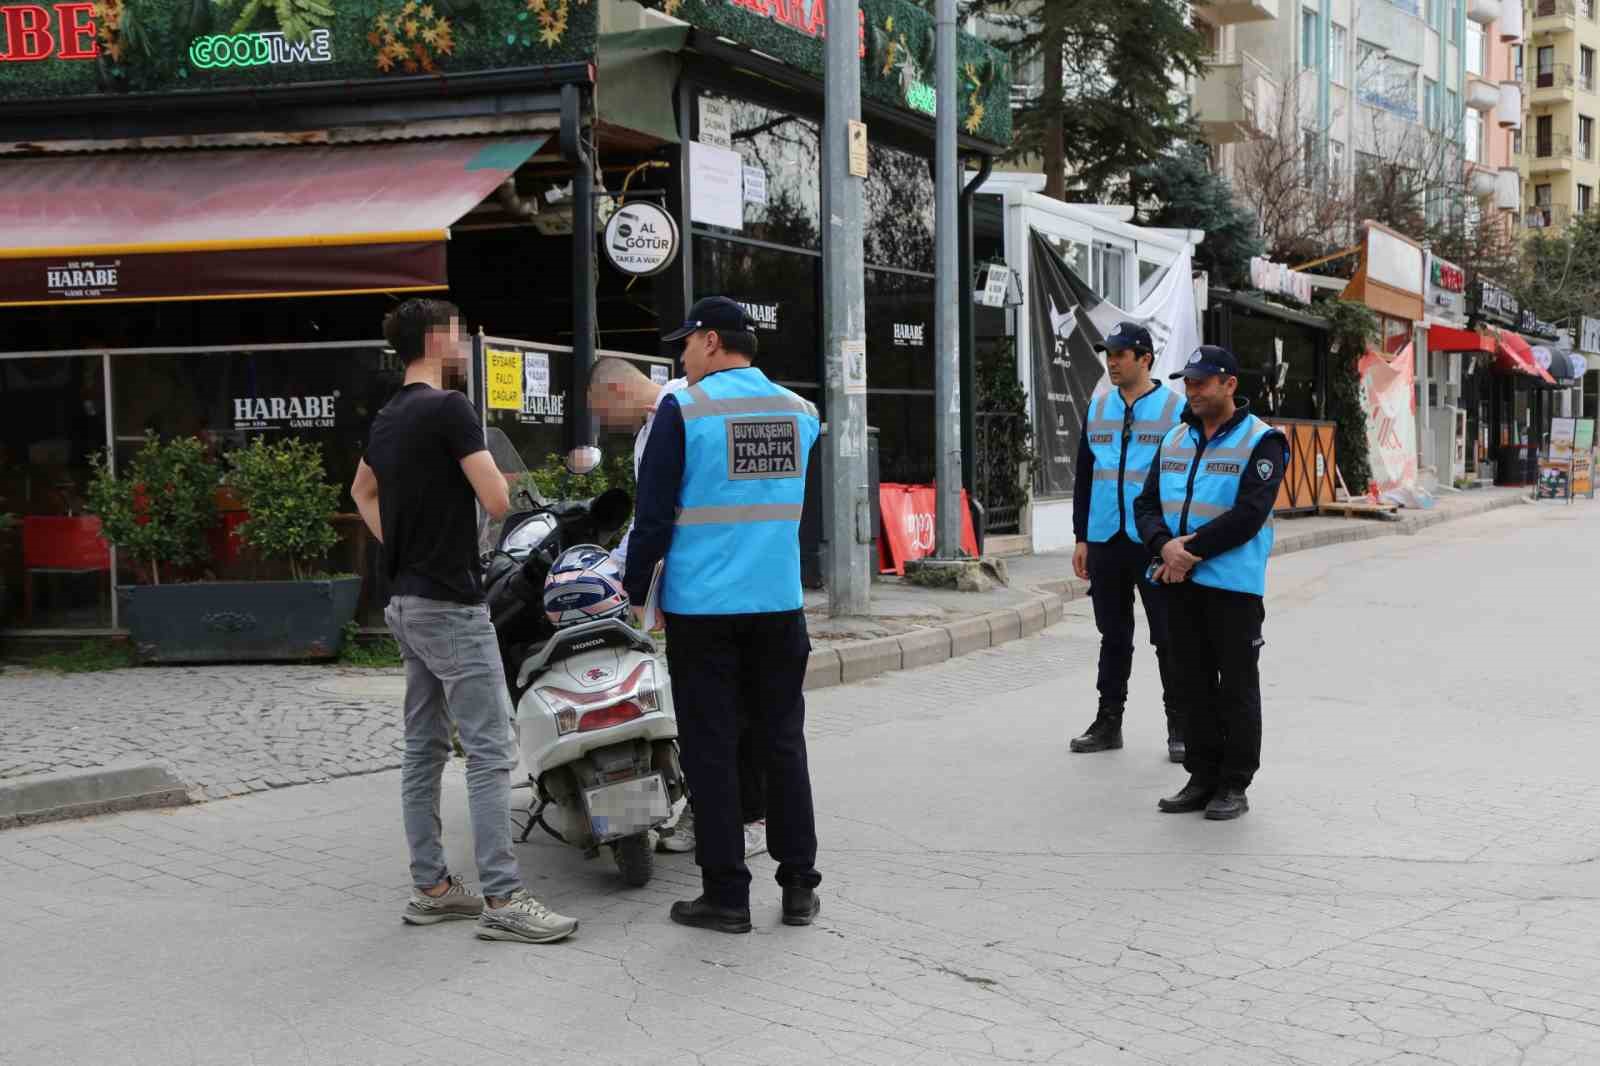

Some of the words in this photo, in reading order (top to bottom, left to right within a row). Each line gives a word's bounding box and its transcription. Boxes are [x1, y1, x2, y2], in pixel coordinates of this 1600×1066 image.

[0, 3, 98, 61] BE
[640, 223, 656, 233] AL
[625, 236, 669, 249] GÖTÜR
[615, 255, 634, 264] TAKE
[47, 269, 118, 288] HARABE
[736, 302, 777, 323] ARABE
[234, 396, 335, 420] HARABE
[289, 419, 313, 428] GAME
[736, 457, 796, 473] ZABITA
[572, 638, 605, 650] HONDA
